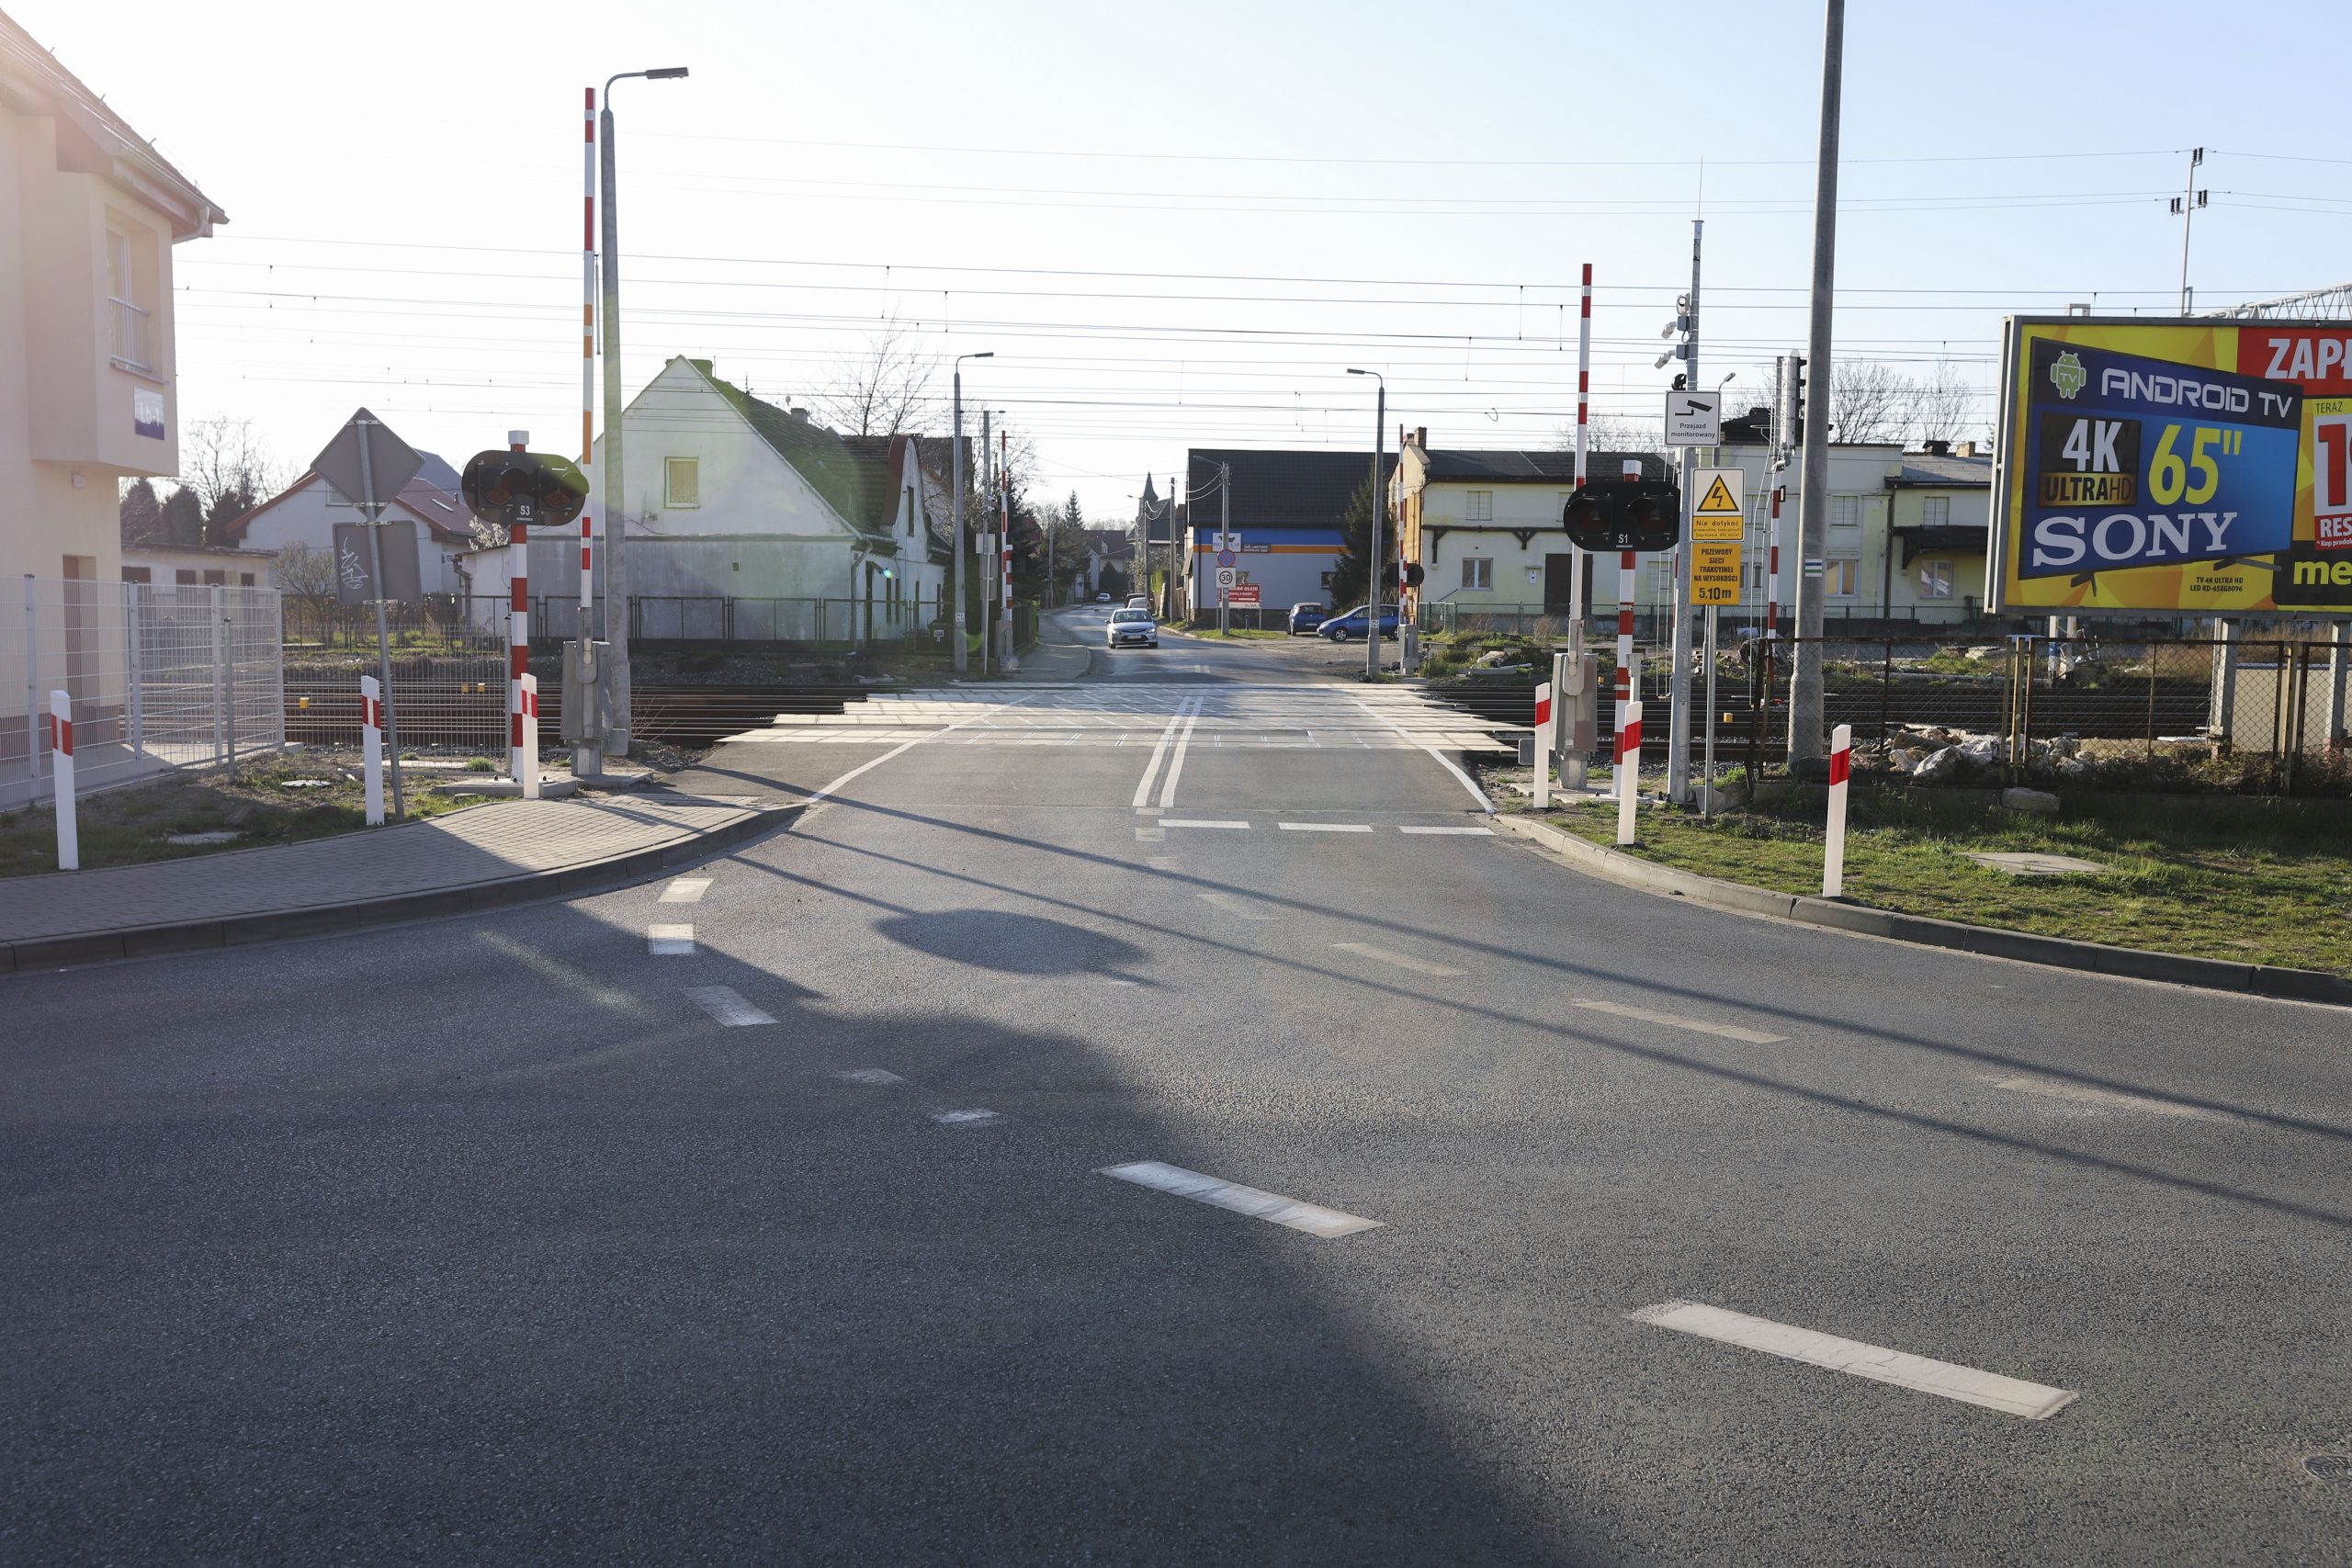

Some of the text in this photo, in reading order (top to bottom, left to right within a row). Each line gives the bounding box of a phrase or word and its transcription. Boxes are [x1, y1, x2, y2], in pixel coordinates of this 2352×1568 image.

[2060, 373, 2077, 383] TV
[2101, 367, 2293, 418] ANDROID TV
[2315, 401, 2344, 413] TERAZ
[2062, 418, 2122, 472] 4K
[2318, 423, 2352, 507] 1
[520, 504, 530, 515] S3
[1618, 533, 1628, 544] S1
[2032, 512, 2238, 567] SONY
[1702, 574, 1738, 582] WYSOKOŚCI
